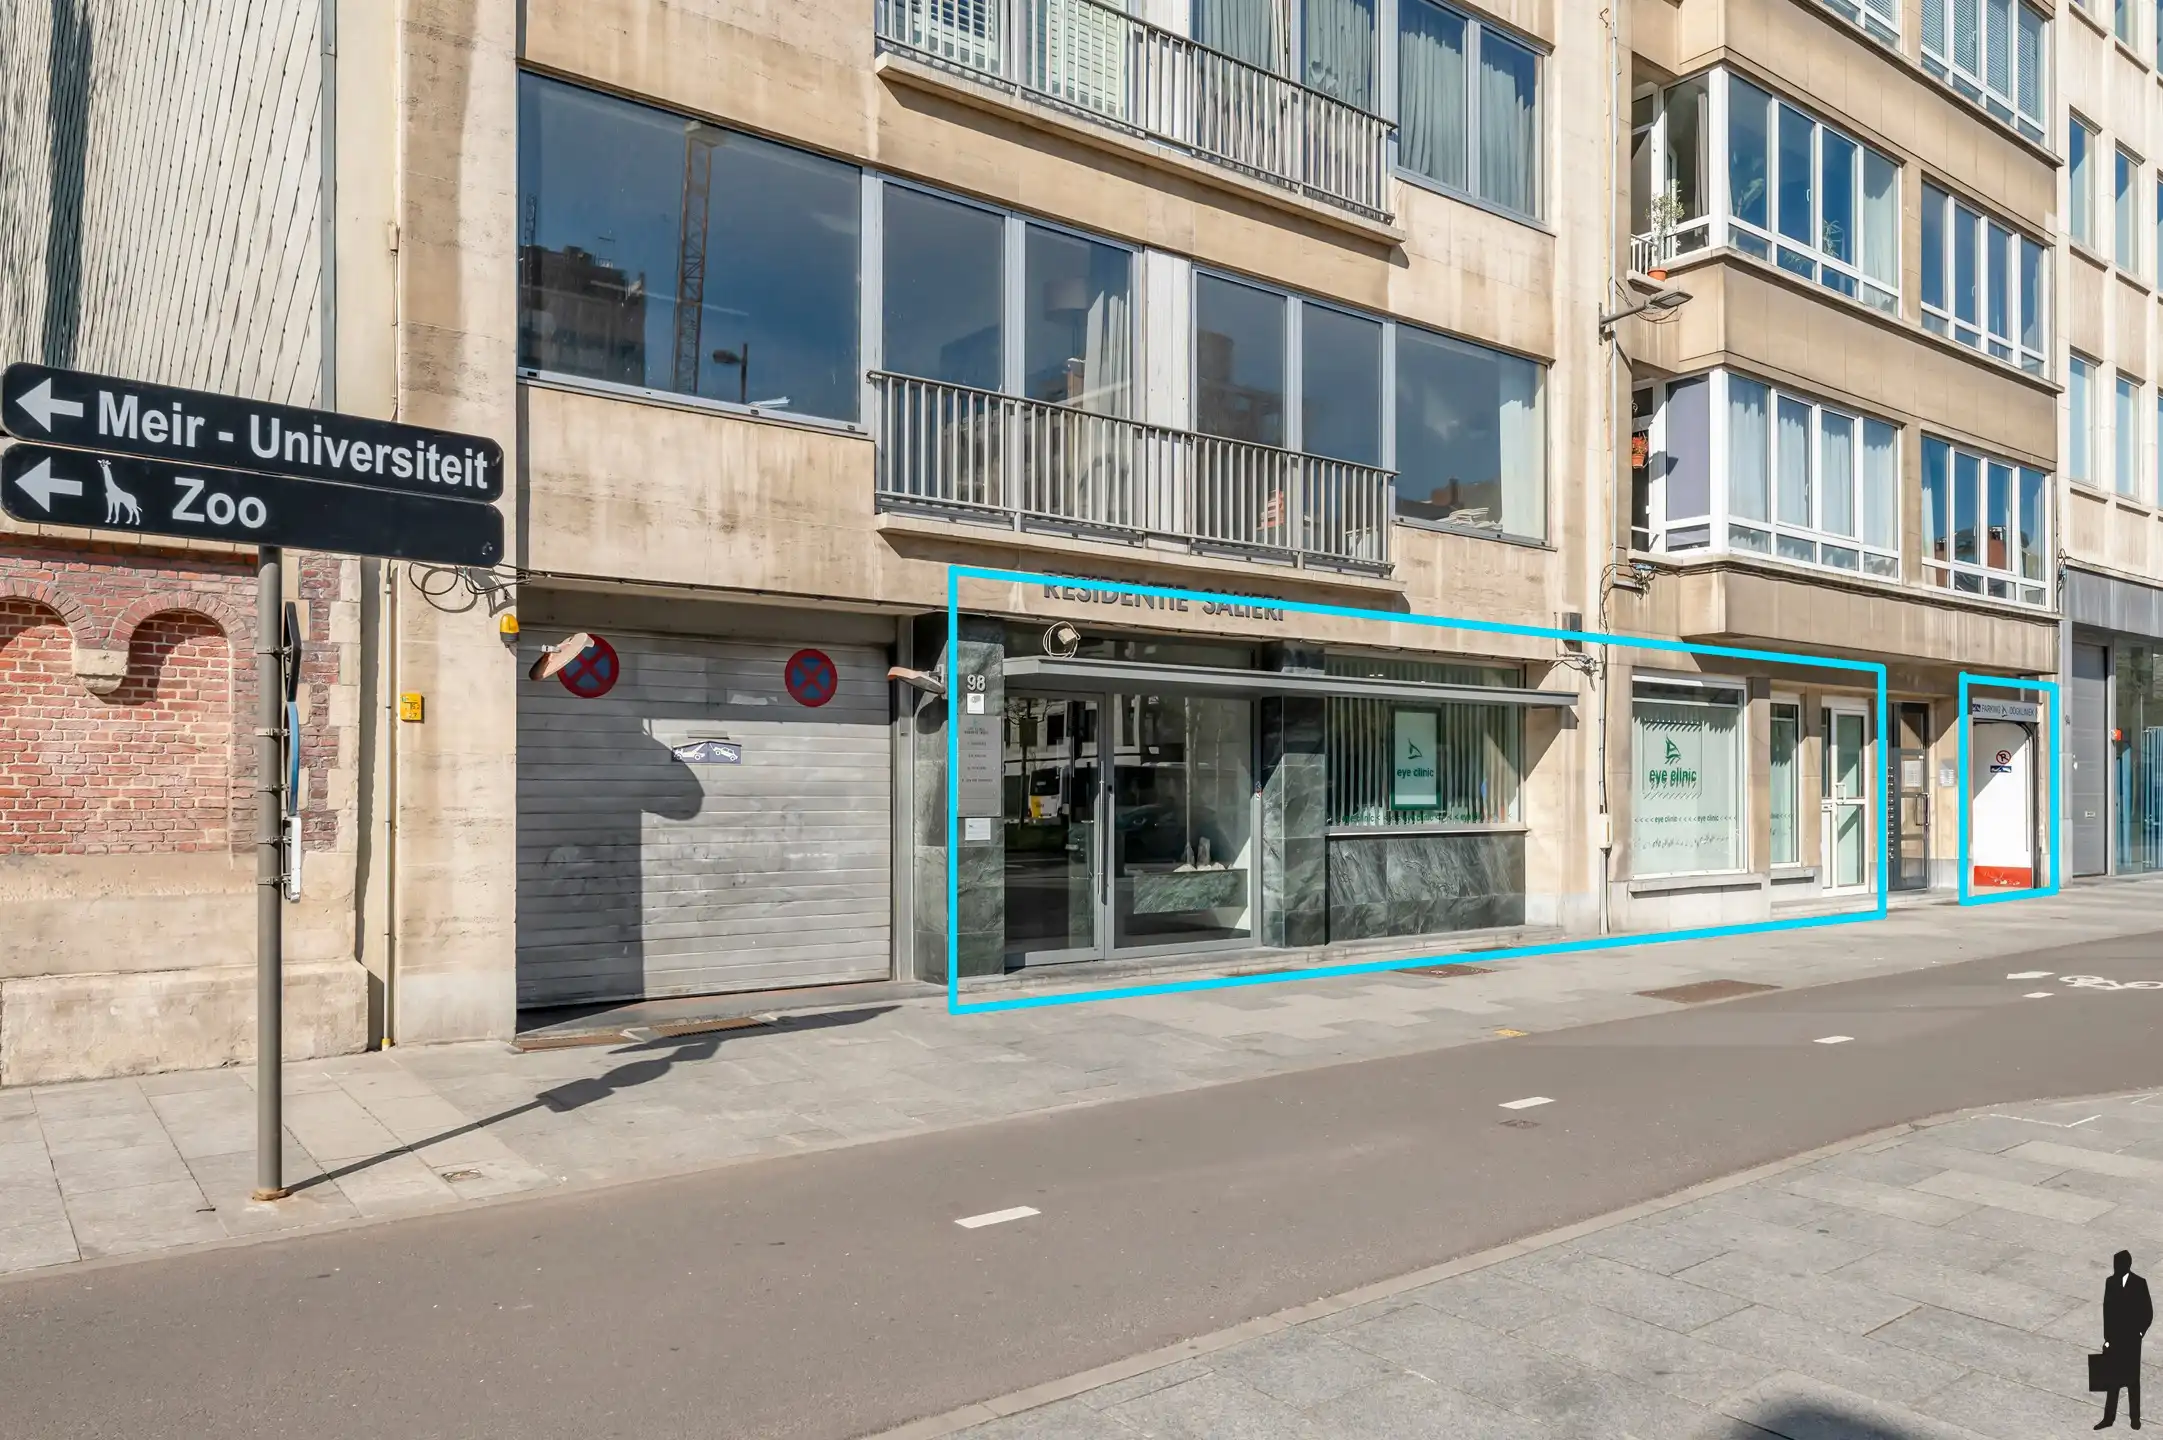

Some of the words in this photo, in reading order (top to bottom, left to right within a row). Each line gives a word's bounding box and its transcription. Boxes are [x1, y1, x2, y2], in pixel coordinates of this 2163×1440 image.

[98, 389, 205, 448] Meir
[217, 431, 234, 442] -
[250, 414, 488, 490] Universiteit
[172, 476, 267, 529] Zoo
[1042, 570, 1188, 612] RESIDENTIE
[1202, 588, 1283, 621] SALIERI
[967, 674, 986, 691] 98
[1396, 769, 1411, 779] eye
[1413, 768, 1434, 777] clinic
[1649, 769, 1667, 785] eye
[1670, 767, 1697, 784] clinic
